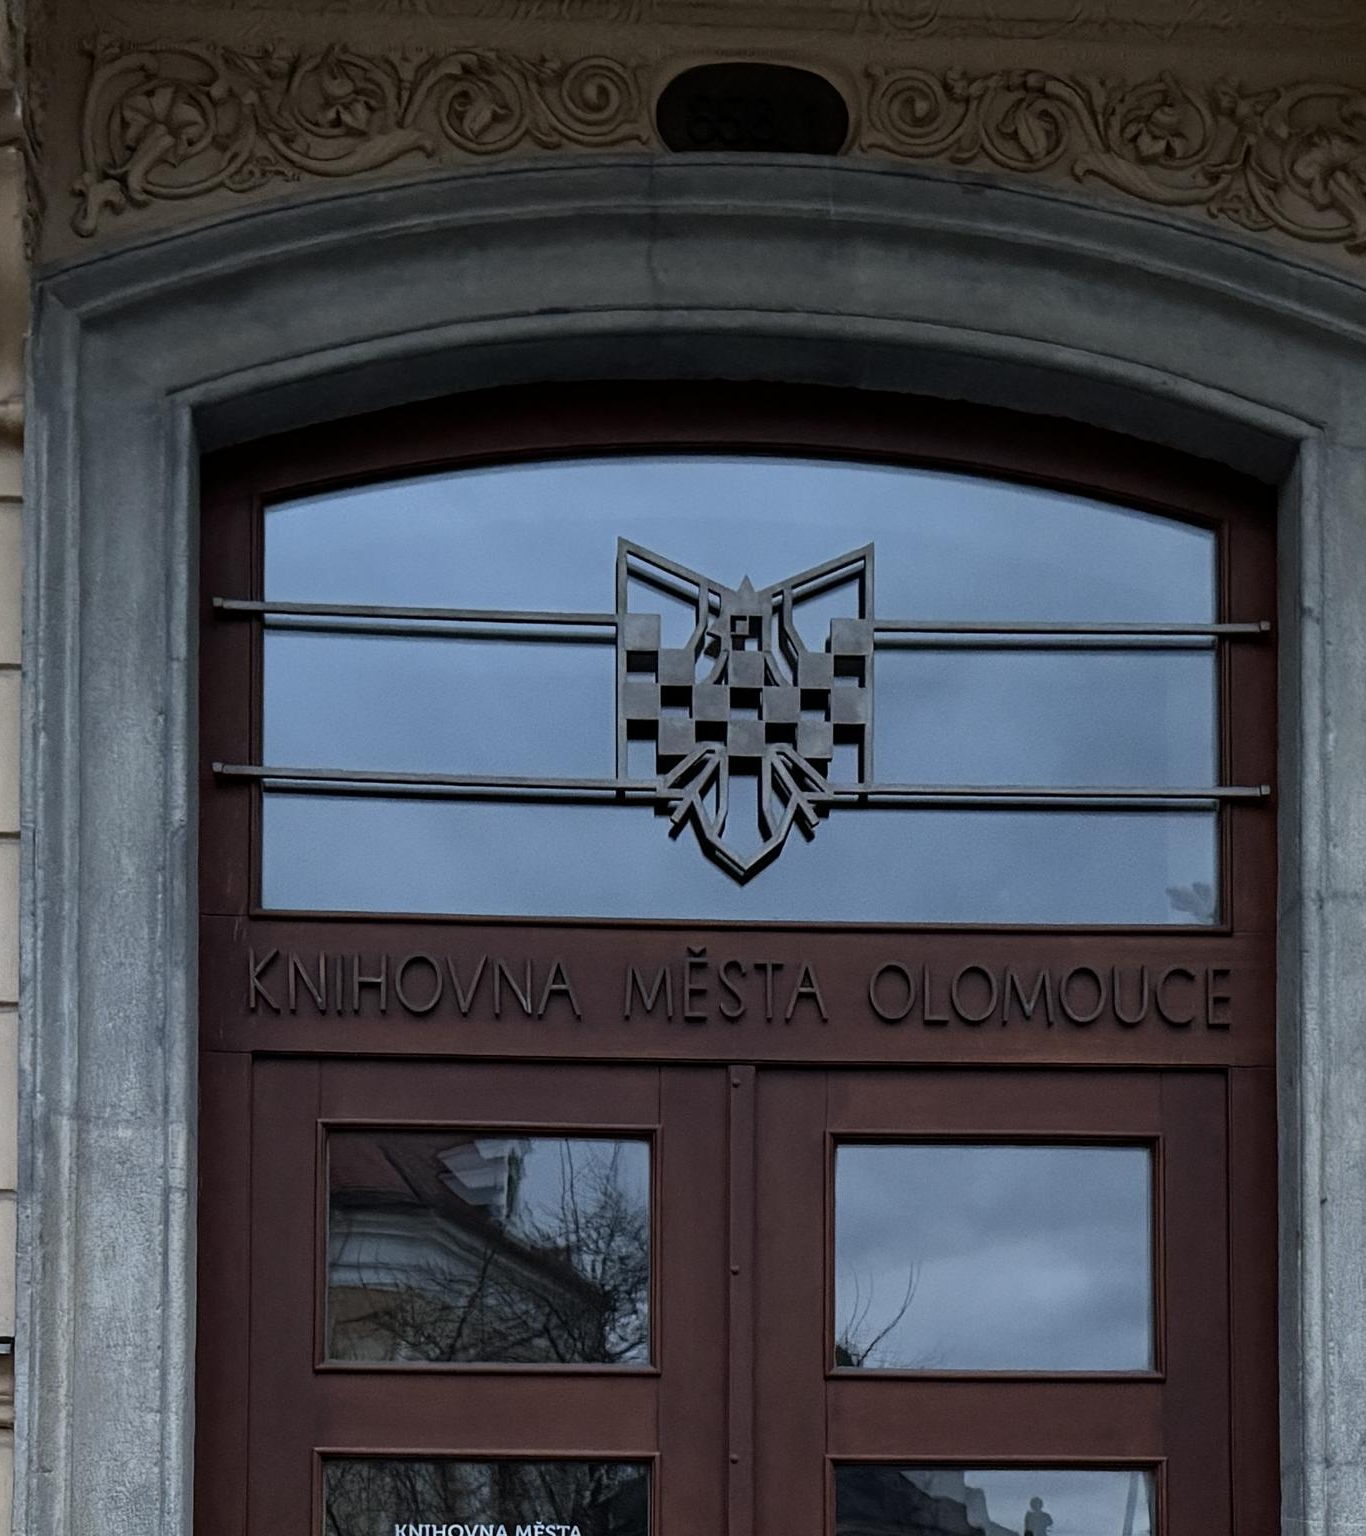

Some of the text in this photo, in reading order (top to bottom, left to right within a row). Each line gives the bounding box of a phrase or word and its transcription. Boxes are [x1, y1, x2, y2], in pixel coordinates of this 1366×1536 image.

[248, 945, 1232, 1031] KNIHOVNA MĚSTA OLOMOUCE
